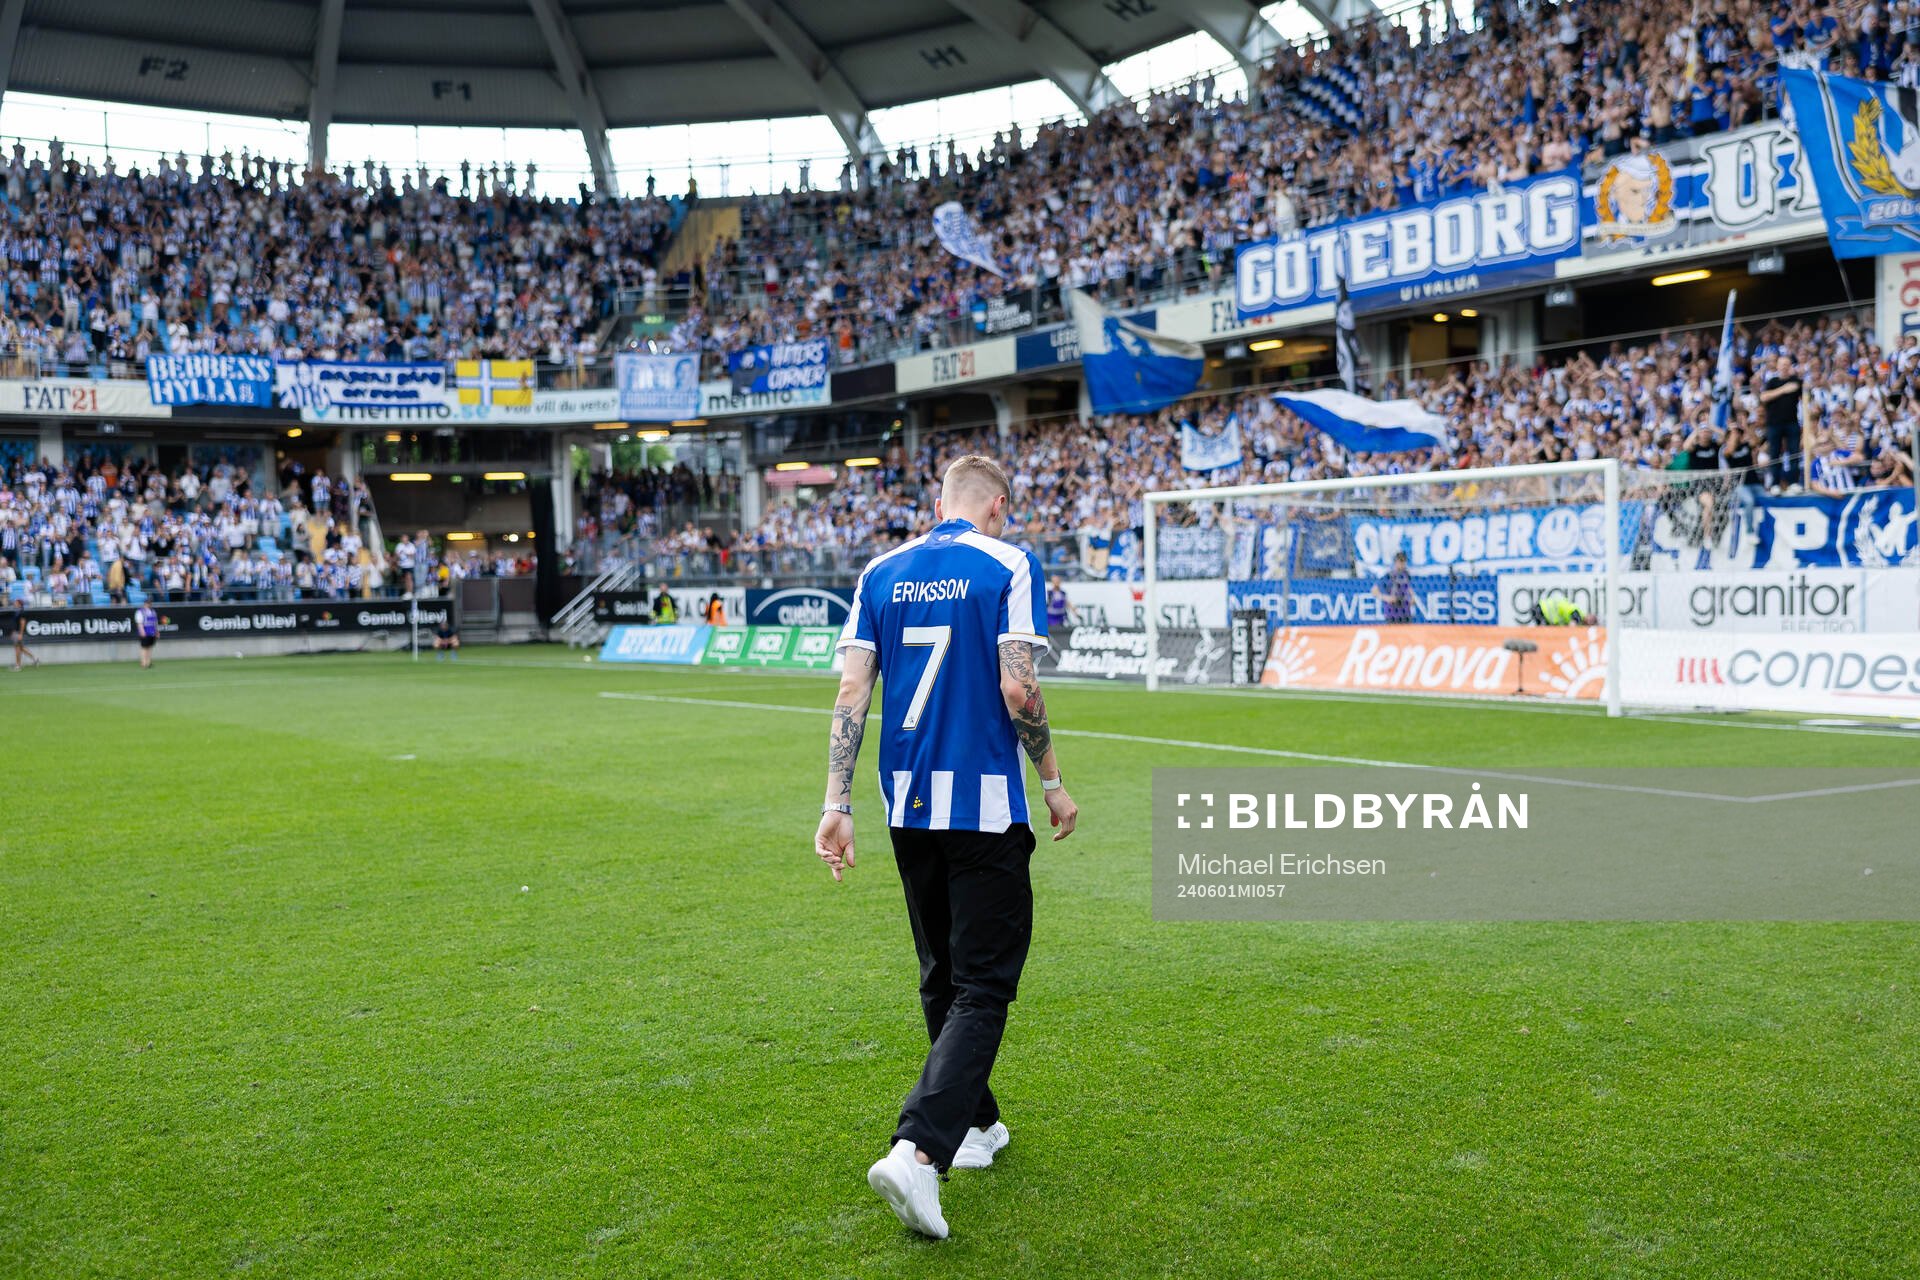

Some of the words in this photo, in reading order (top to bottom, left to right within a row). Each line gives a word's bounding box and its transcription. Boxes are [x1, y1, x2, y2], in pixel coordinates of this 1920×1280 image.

[138, 55, 189, 80] F2
[918, 44, 968, 70] H1
[431, 80, 471, 102] F1
[1239, 179, 1578, 308] GÖTEBORG
[22, 386, 99, 412] FAT21
[892, 577, 971, 604] ERIKSSON
[1689, 574, 1855, 627] granitor
[357, 610, 405, 626] Gamla
[1133, 605, 1200, 629] RSTA
[1229, 589, 1498, 622] NORDICWELNESS
[26, 620, 82, 636] Gamla
[84, 617, 132, 634] Ullevi
[198, 614, 251, 631] Gamla
[252, 612, 297, 629] Ullevi
[1337, 628, 1513, 691] Renova
[902, 625, 951, 731] 7
